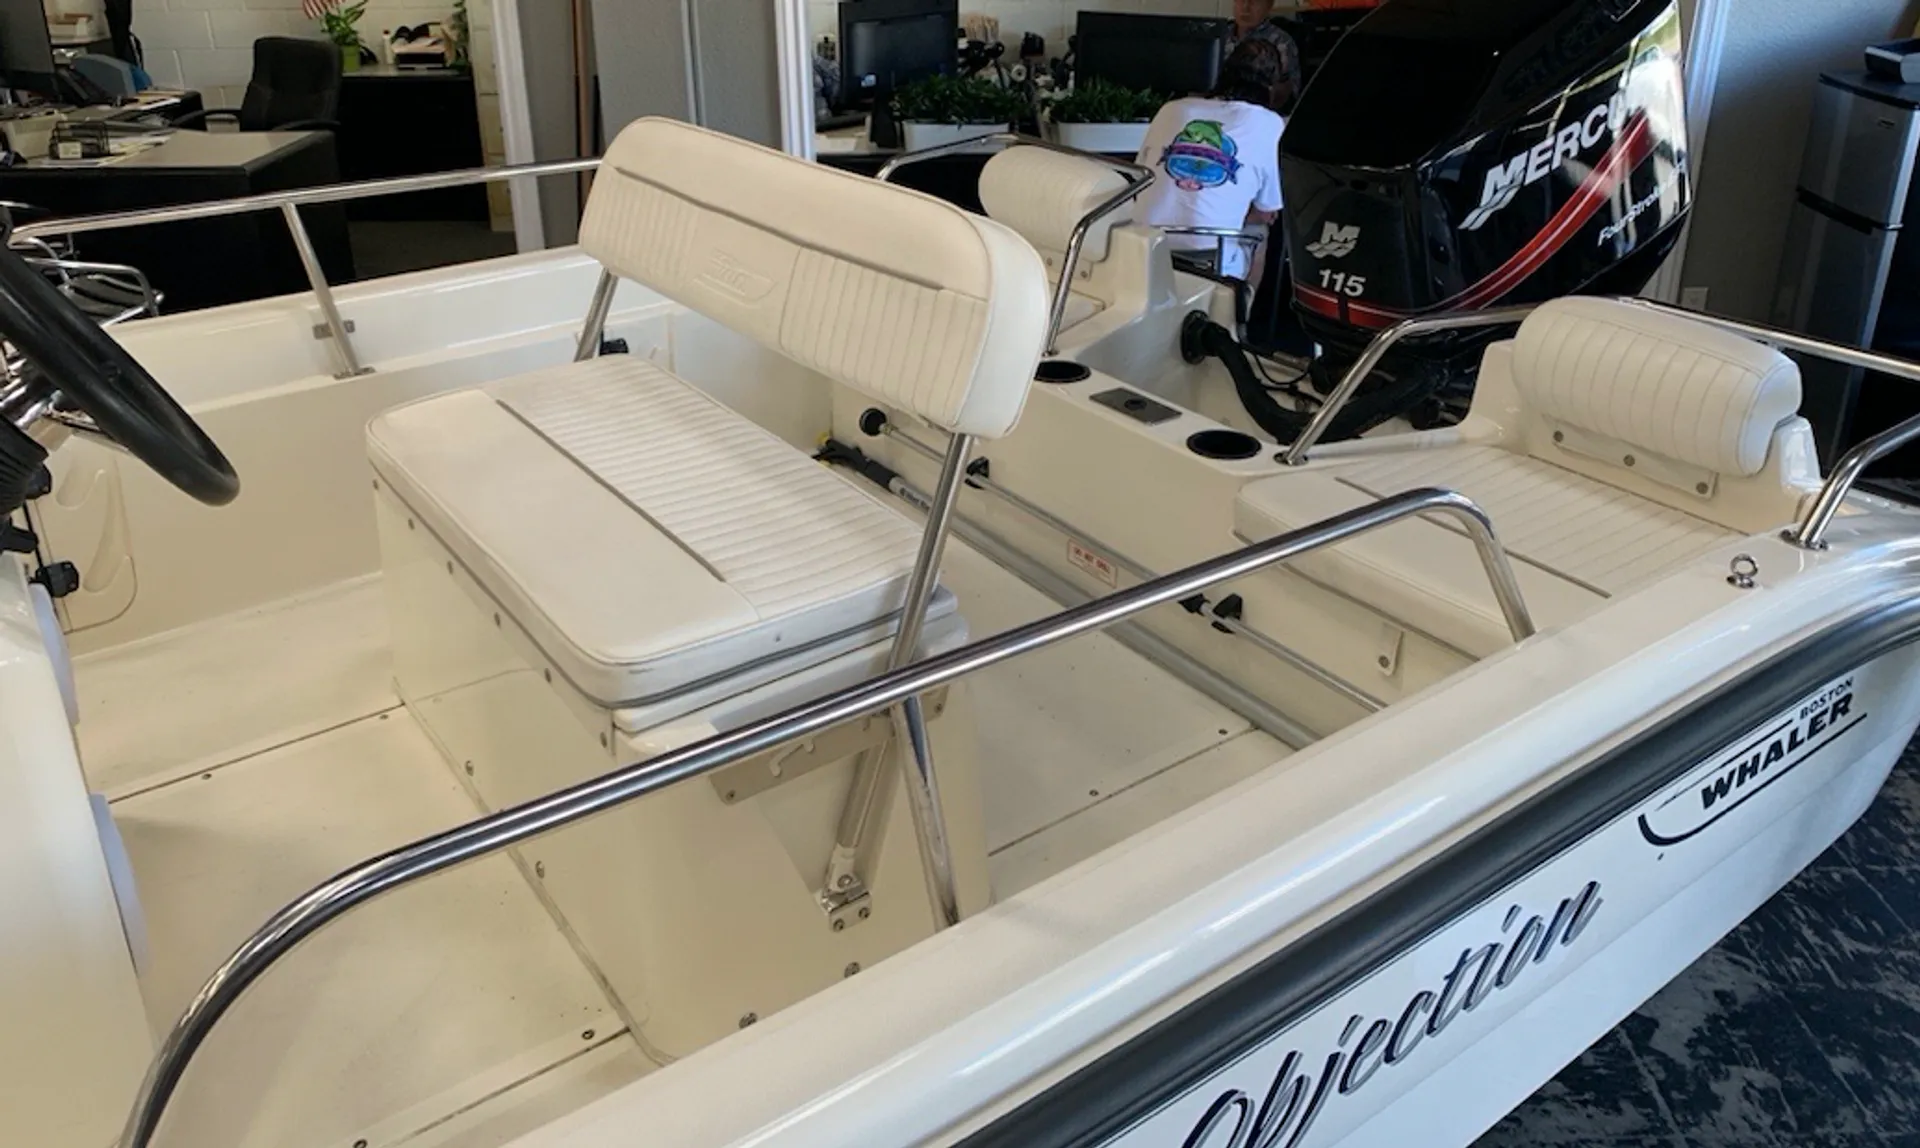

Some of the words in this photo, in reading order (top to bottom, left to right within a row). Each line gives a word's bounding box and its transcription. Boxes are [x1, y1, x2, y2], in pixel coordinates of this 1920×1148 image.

[1458, 95, 1630, 230] MERCU
[1319, 268, 1367, 297] 115
[1701, 692, 1853, 810] WHALER
[1799, 676, 1854, 720] BOSTON
[1181, 880, 1602, 1148] Objection
